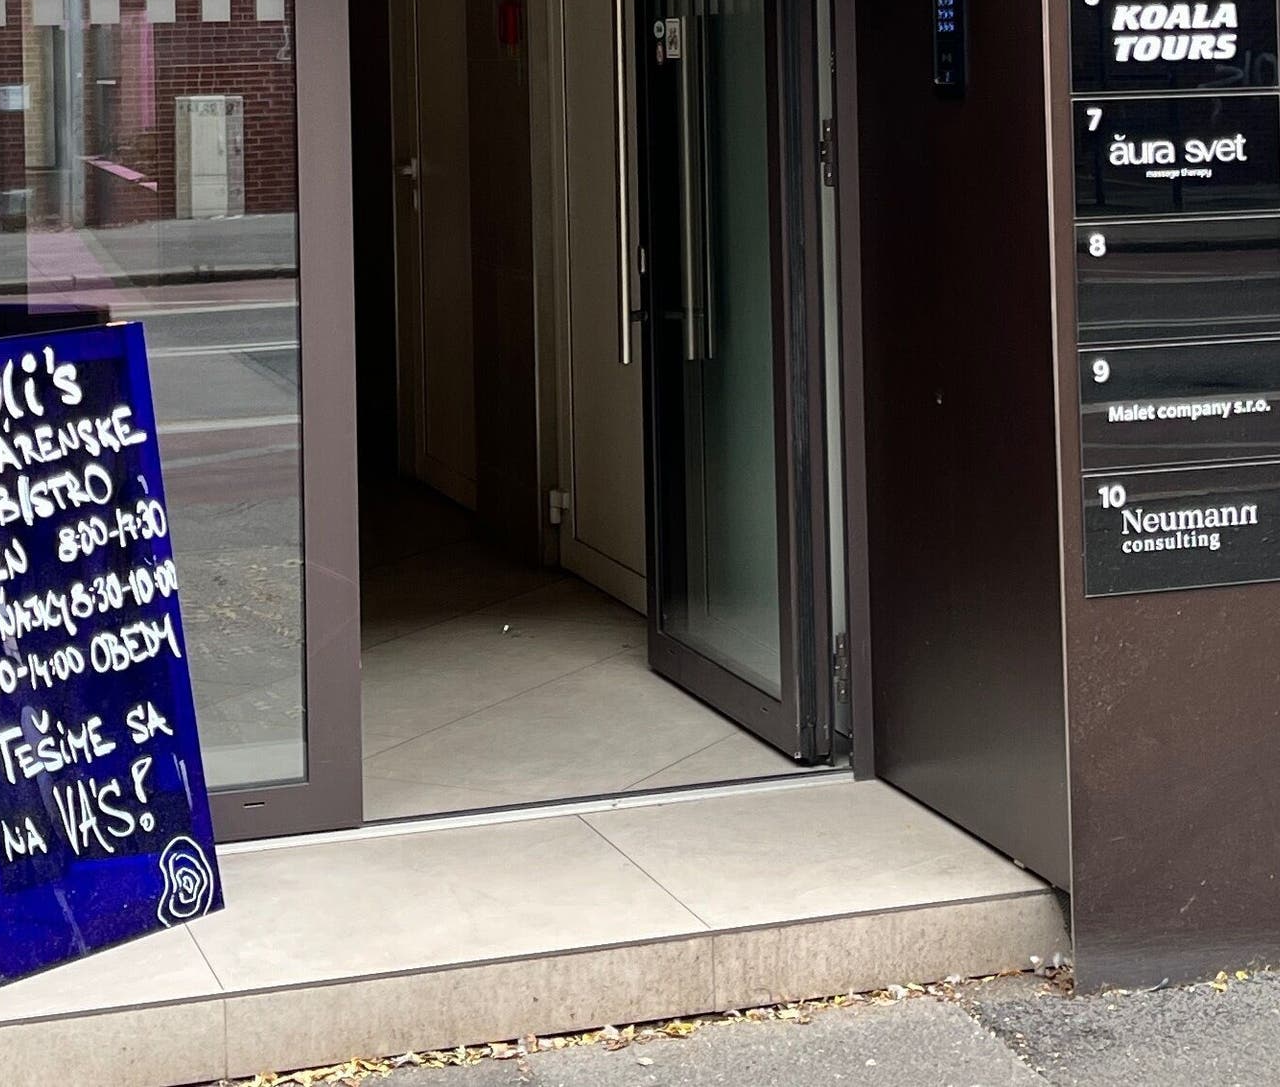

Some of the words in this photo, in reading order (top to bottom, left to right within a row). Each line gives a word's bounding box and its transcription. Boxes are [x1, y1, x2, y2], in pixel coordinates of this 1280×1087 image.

[1112, 3, 1237, 30] KOALA
[1114, 33, 1237, 61] TOURS
[1087, 108, 1102, 130] 7
[1185, 134, 1247, 162] svet
[1180, 168, 1212, 177] therapy
[1089, 233, 1106, 256] 8
[1093, 359, 1109, 382] 9
[1109, 404, 1155, 422] Malet
[1157, 400, 1231, 420] company
[1232, 398, 1270, 413] s.r.o.
[1098, 484, 1126, 508] 10
[1120, 502, 1257, 535] Neumann
[1122, 530, 1220, 553] consulting
[90, 613, 182, 673] OBEDY
[126, 701, 174, 744] SA
[1, 817, 48, 862] NA
